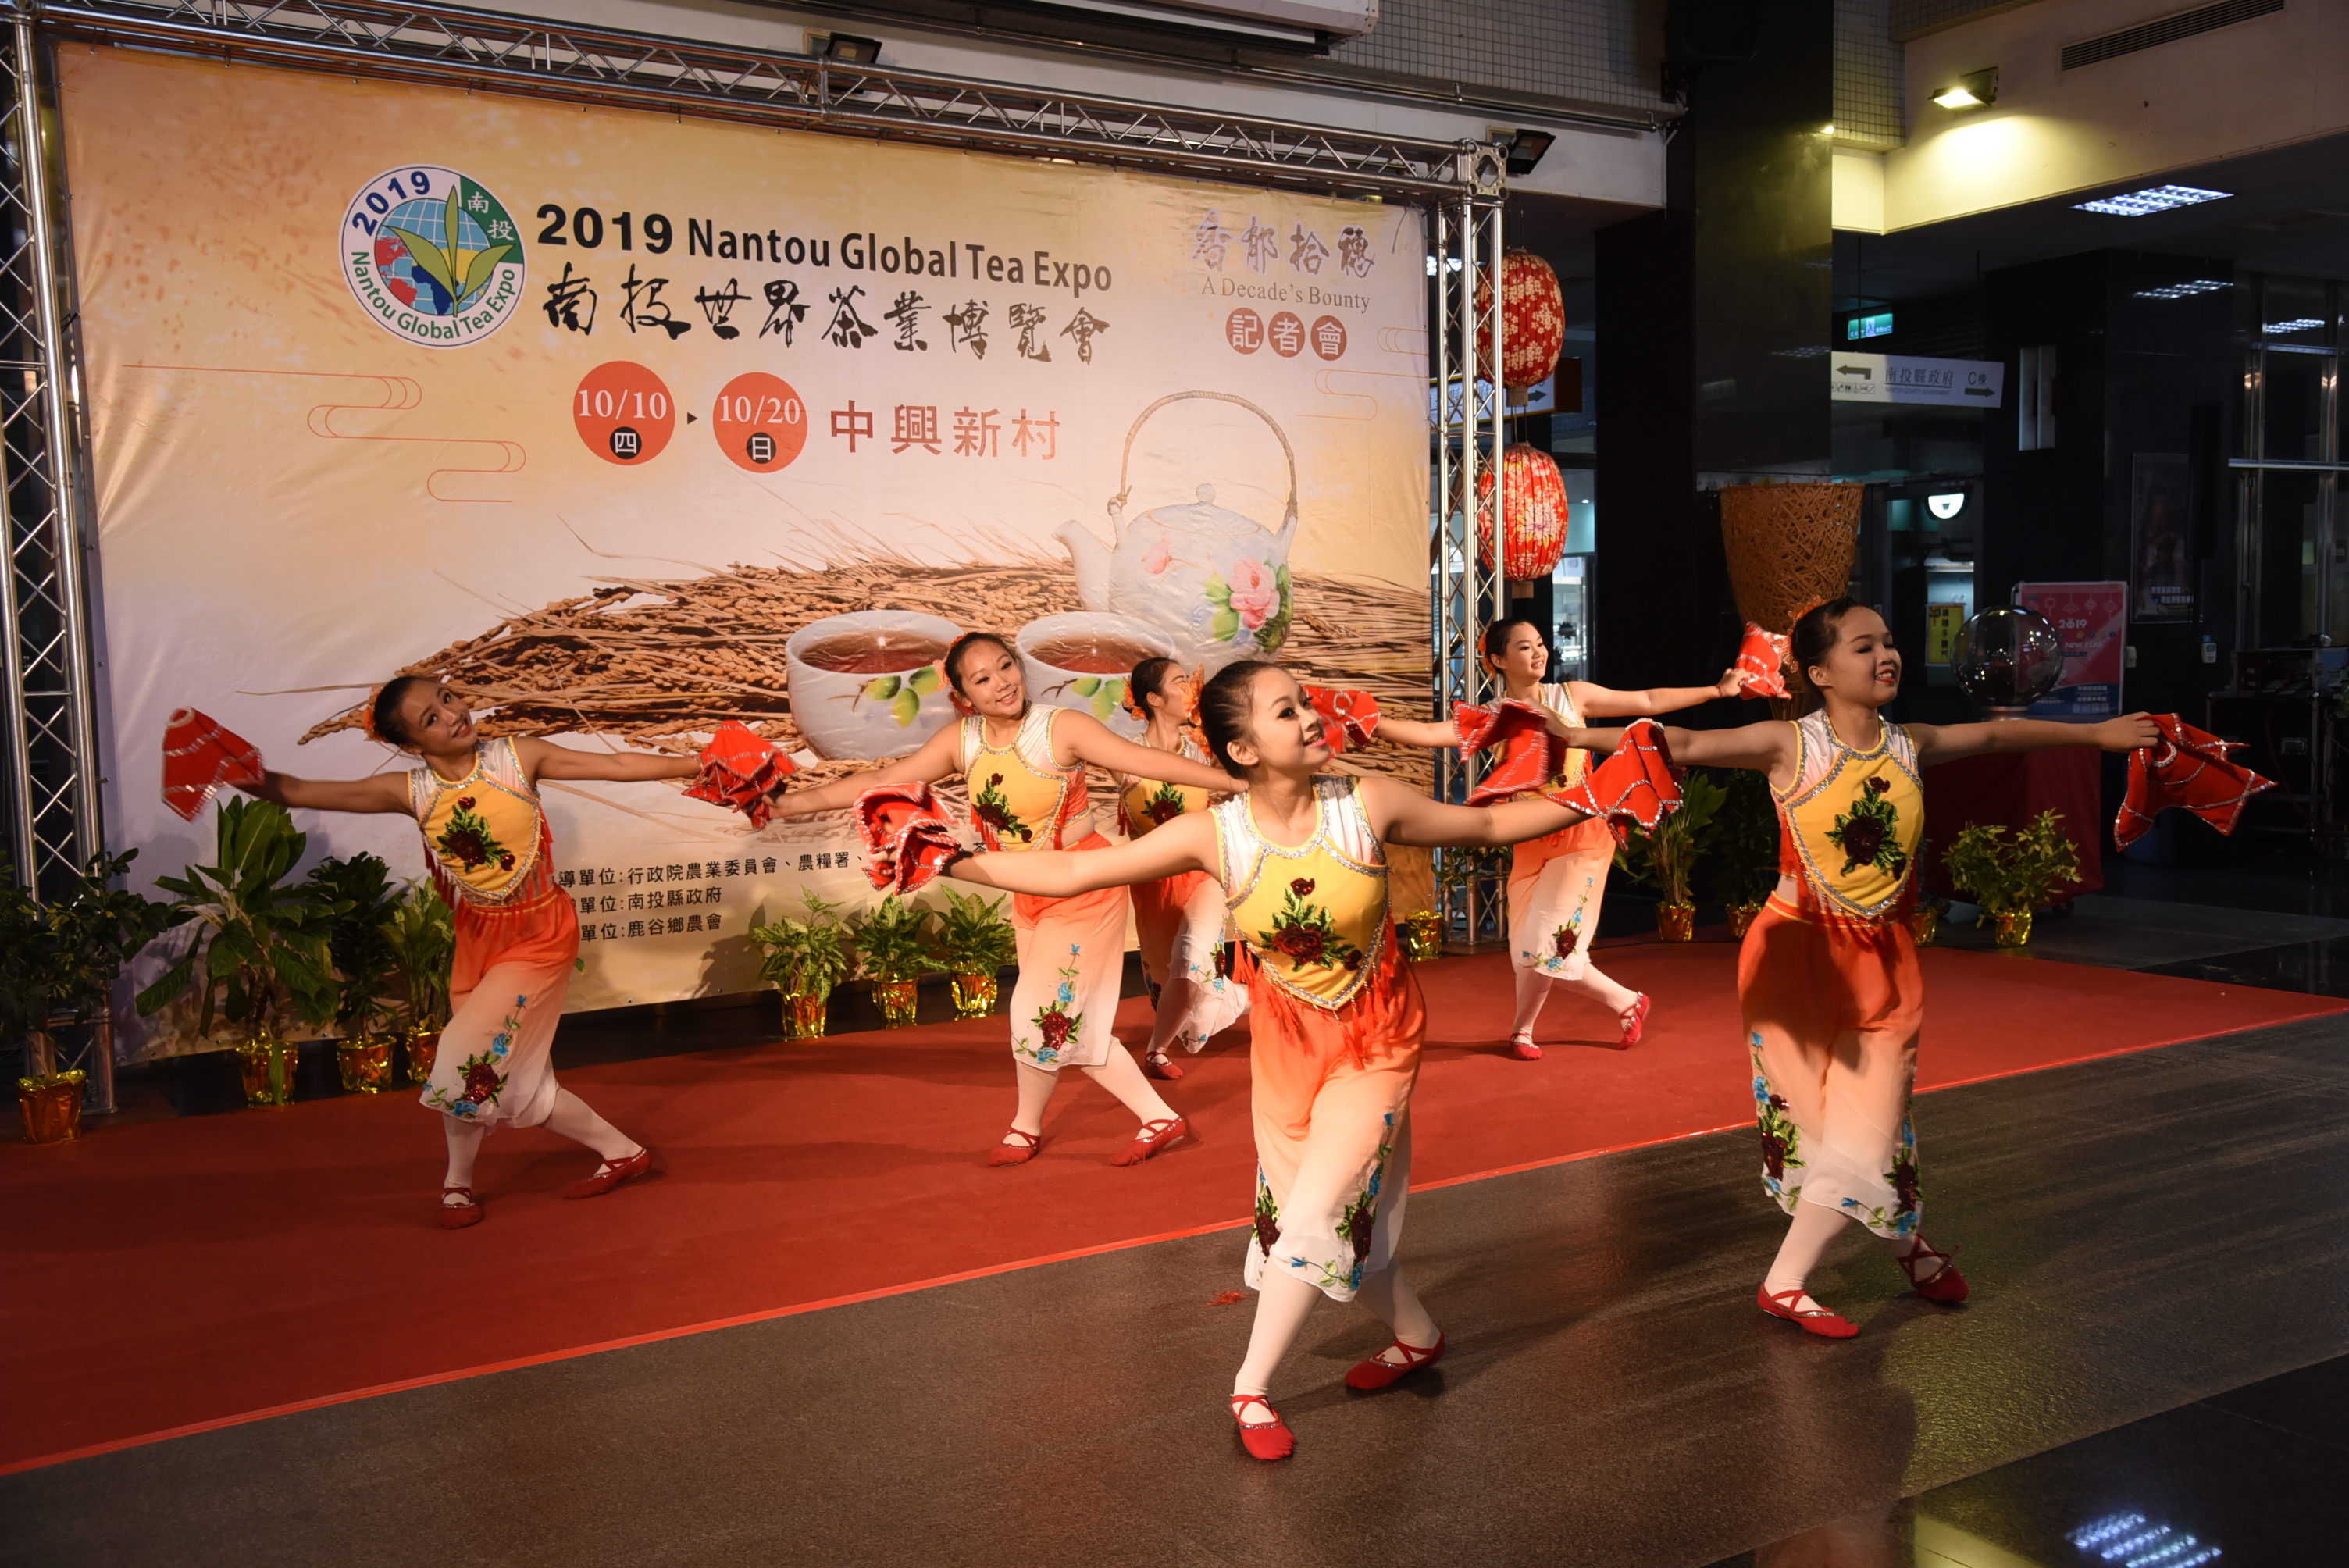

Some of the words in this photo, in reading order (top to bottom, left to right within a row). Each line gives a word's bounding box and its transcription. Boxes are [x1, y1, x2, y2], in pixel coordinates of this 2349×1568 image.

[351, 170, 431, 236] 2019
[467, 191, 514, 241] 南投
[536, 203, 673, 254] 2019
[688, 217, 830, 268] Nantou
[839, 233, 957, 278] Global
[965, 244, 1024, 284] Tea
[1034, 251, 1113, 298] Expo
[351, 251, 396, 321] Nantou
[397, 312, 461, 340] Global
[459, 308, 495, 336] Tea
[486, 268, 516, 316] Expo
[542, 262, 1110, 367] 南投世界茶業博覽會
[1201, 276, 1216, 295] A
[1308, 286, 1371, 314] Bounty
[1232, 314, 1342, 356] 記者會
[1885, 366, 1955, 386] 南投縣政府
[578, 389, 668, 420] 10/10
[719, 395, 801, 426] 10/20
[615, 431, 637, 454] 四
[751, 437, 772, 461] 日
[830, 400, 1060, 461] 中興新村
[572, 886, 722, 915] 單位:南投縣政府
[580, 912, 722, 942] 單位:鹿谷鄉農會
